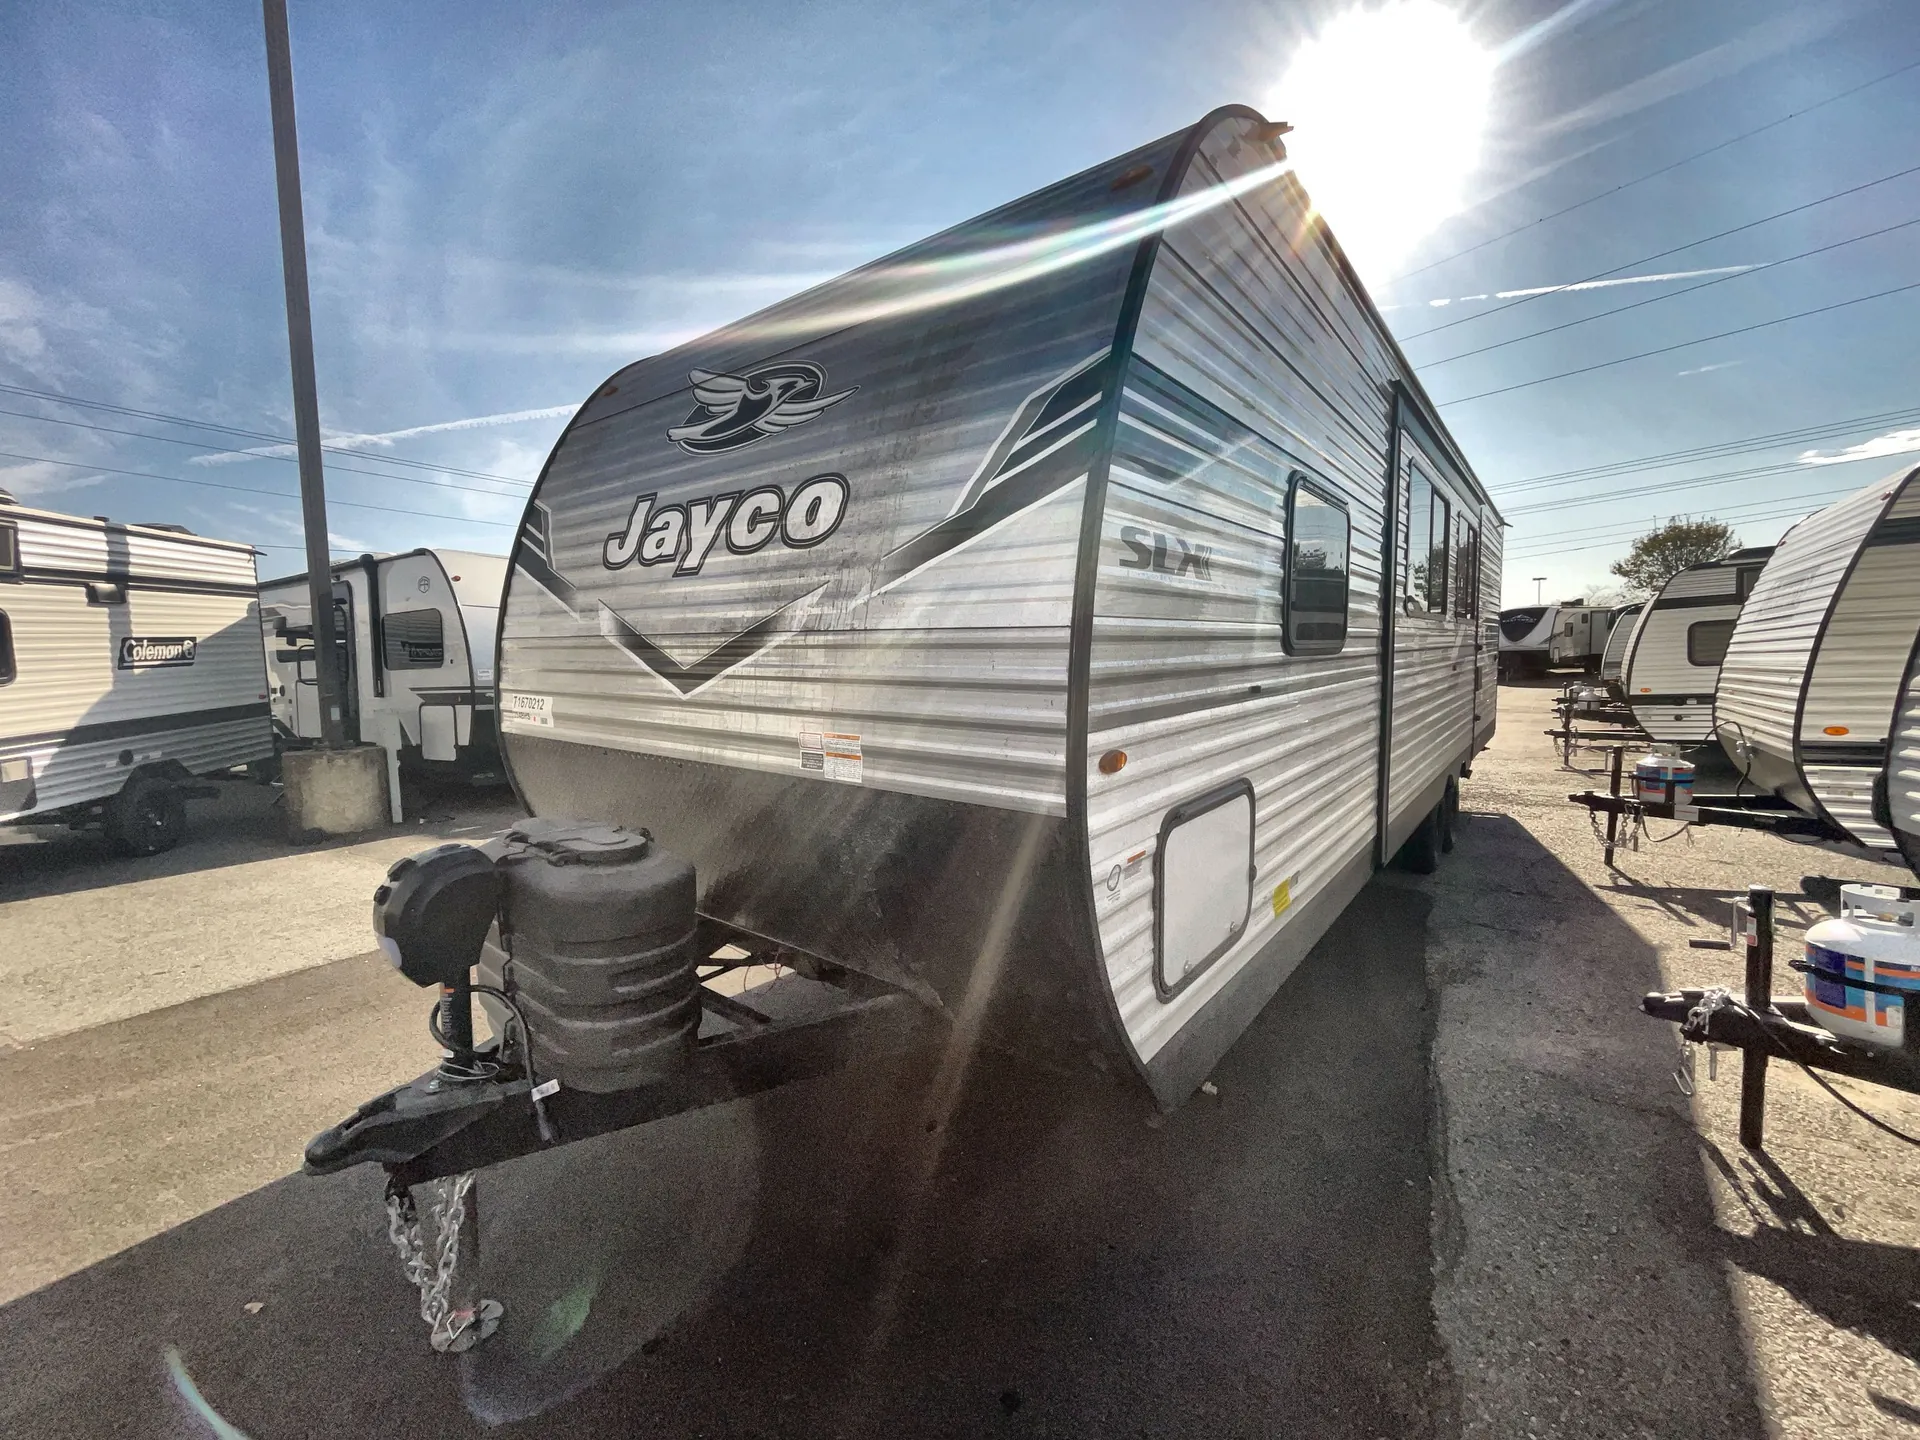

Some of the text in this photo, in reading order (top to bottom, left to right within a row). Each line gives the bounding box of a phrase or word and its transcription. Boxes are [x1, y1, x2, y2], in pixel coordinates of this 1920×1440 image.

[602, 472, 850, 578] Jayco
[1119, 525, 1212, 581] SLX
[123, 639, 183, 661] Coleman
[513, 695, 545, 711] T1670212
